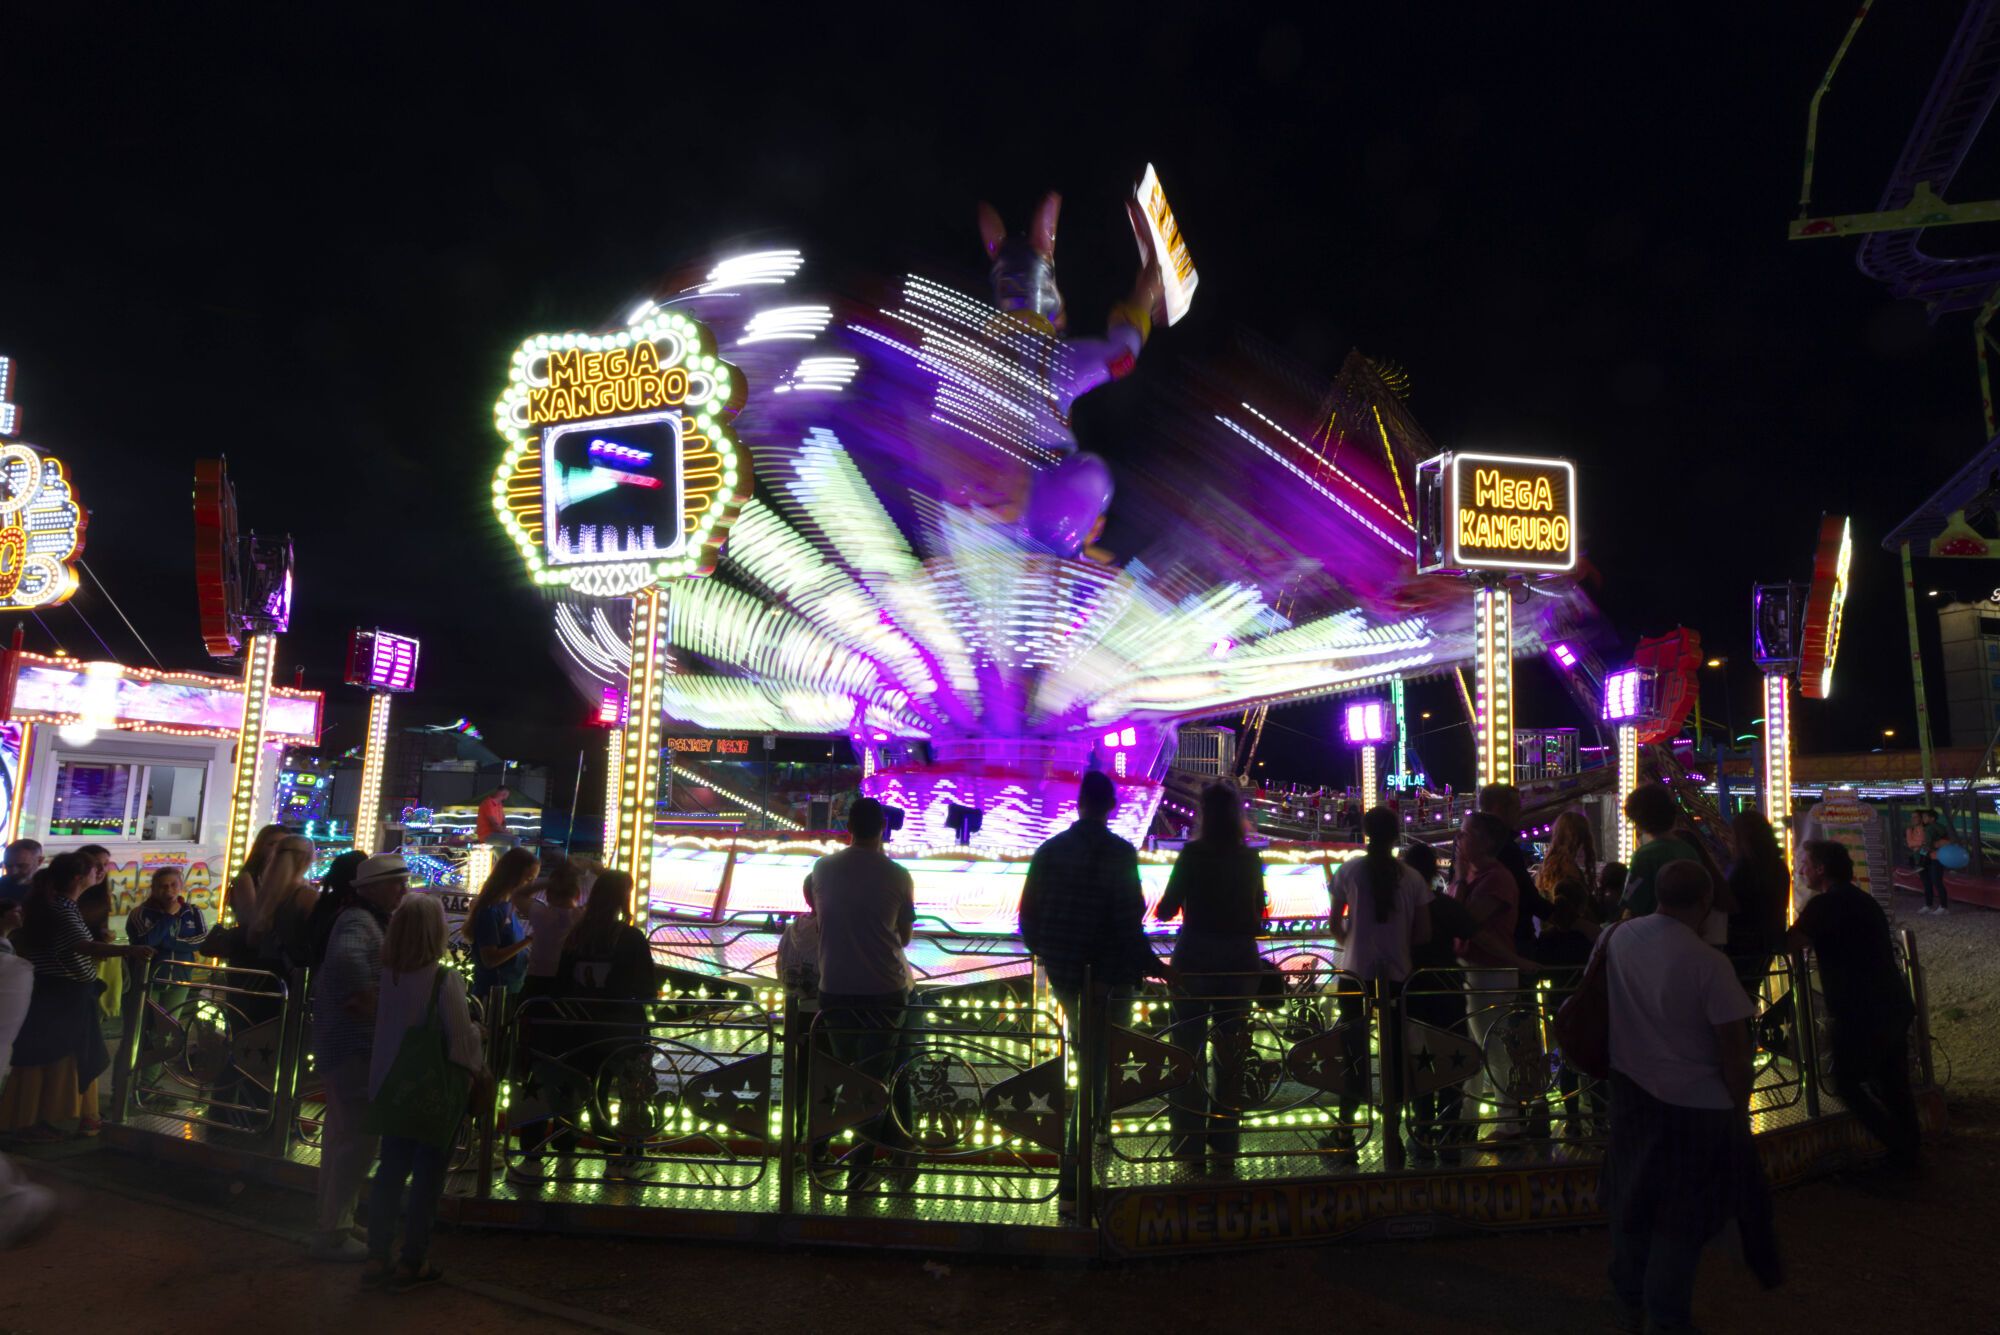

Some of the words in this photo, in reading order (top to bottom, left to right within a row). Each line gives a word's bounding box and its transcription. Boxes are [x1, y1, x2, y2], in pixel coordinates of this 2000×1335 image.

[547, 340, 660, 388] MEGA
[527, 368, 690, 423] KANGURO
[1475, 468, 1554, 512] MEGA
[1459, 509, 1570, 553] KANGURO
[570, 562, 658, 597] XXXL
[667, 737, 713, 752] DONKEY
[107, 860, 212, 893] MEA
[1135, 1188, 1286, 1247] MEGA
[1299, 1174, 1522, 1234] KANGURO
